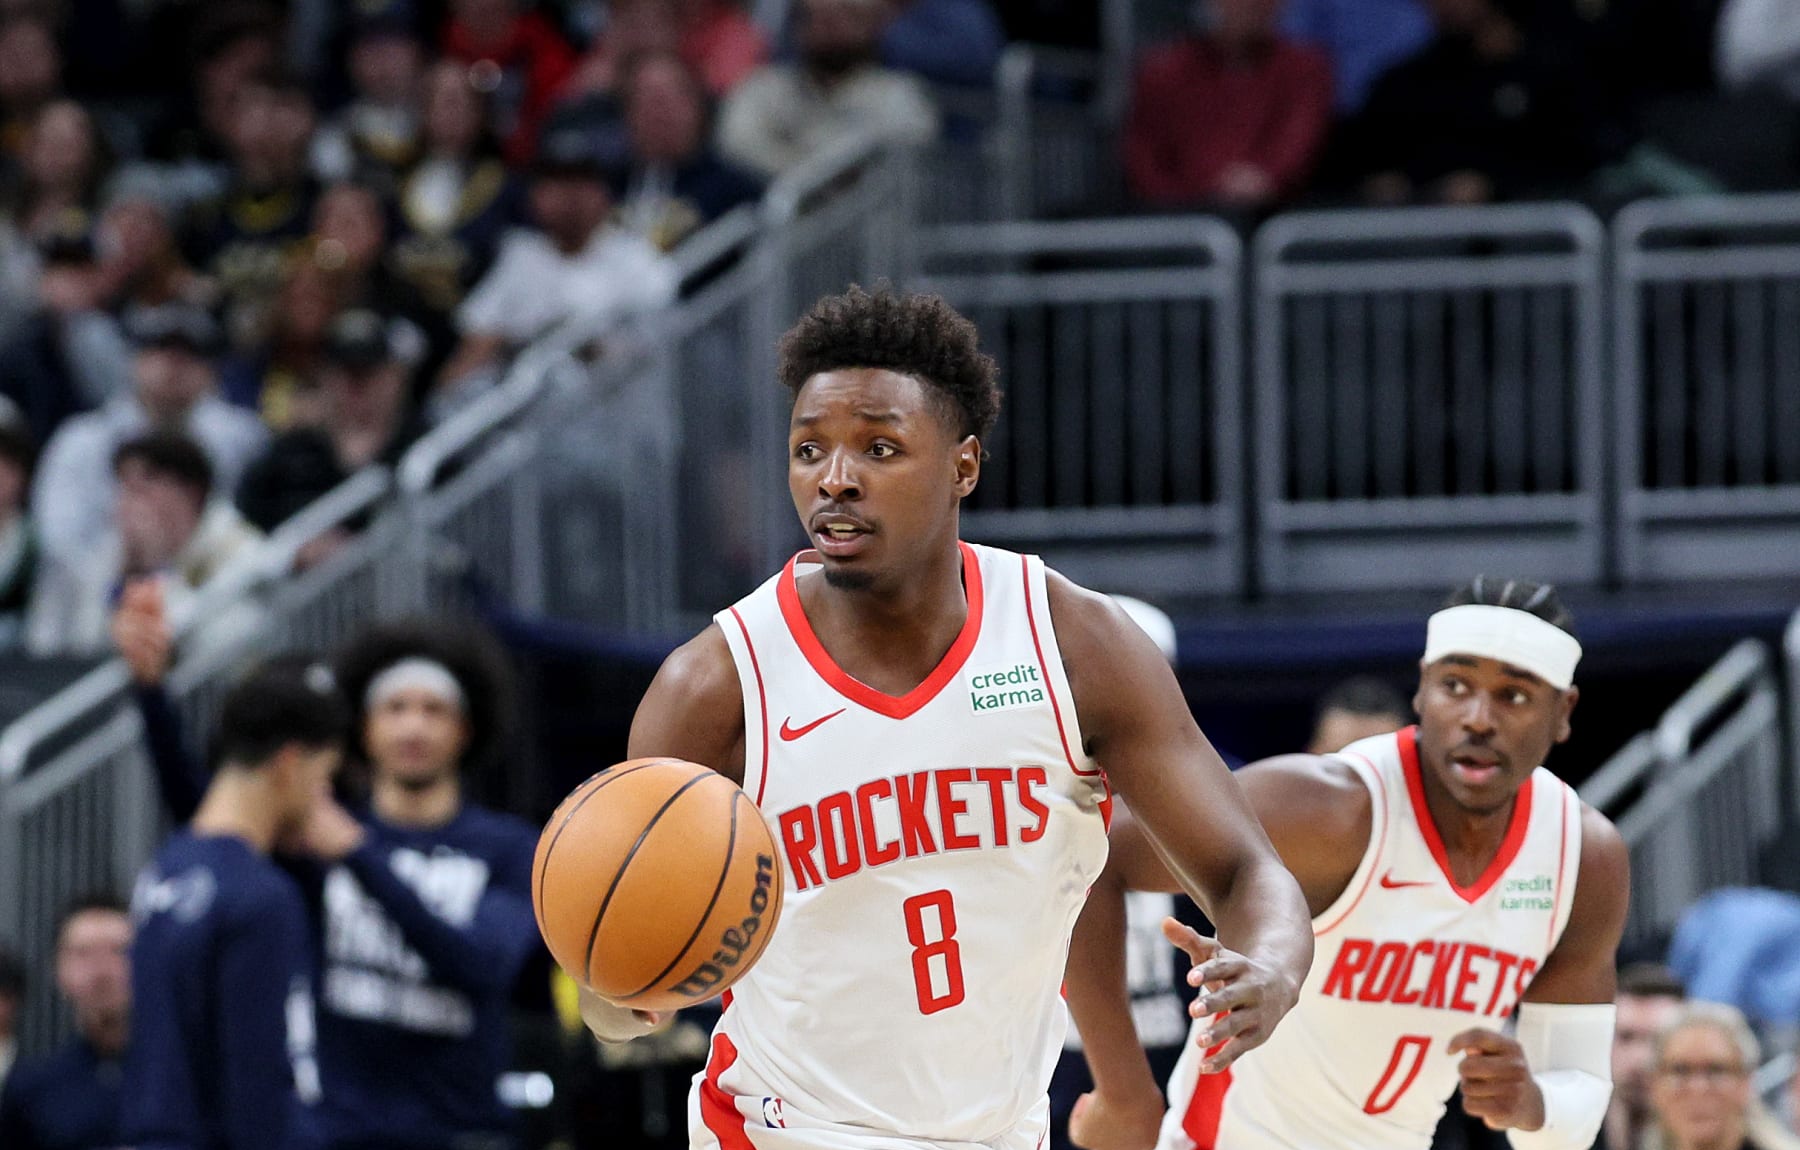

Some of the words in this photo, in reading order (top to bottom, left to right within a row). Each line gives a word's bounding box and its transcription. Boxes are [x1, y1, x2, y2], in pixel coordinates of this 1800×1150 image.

[971, 688, 1044, 711] karma
[972, 665, 1038, 689] credit
[778, 767, 1050, 893] ROCKETS
[666, 852, 773, 997] Wilson
[903, 889, 965, 1015] 8
[1321, 938, 1538, 1018] ROCKETS
[1363, 1035, 1432, 1116] 0
